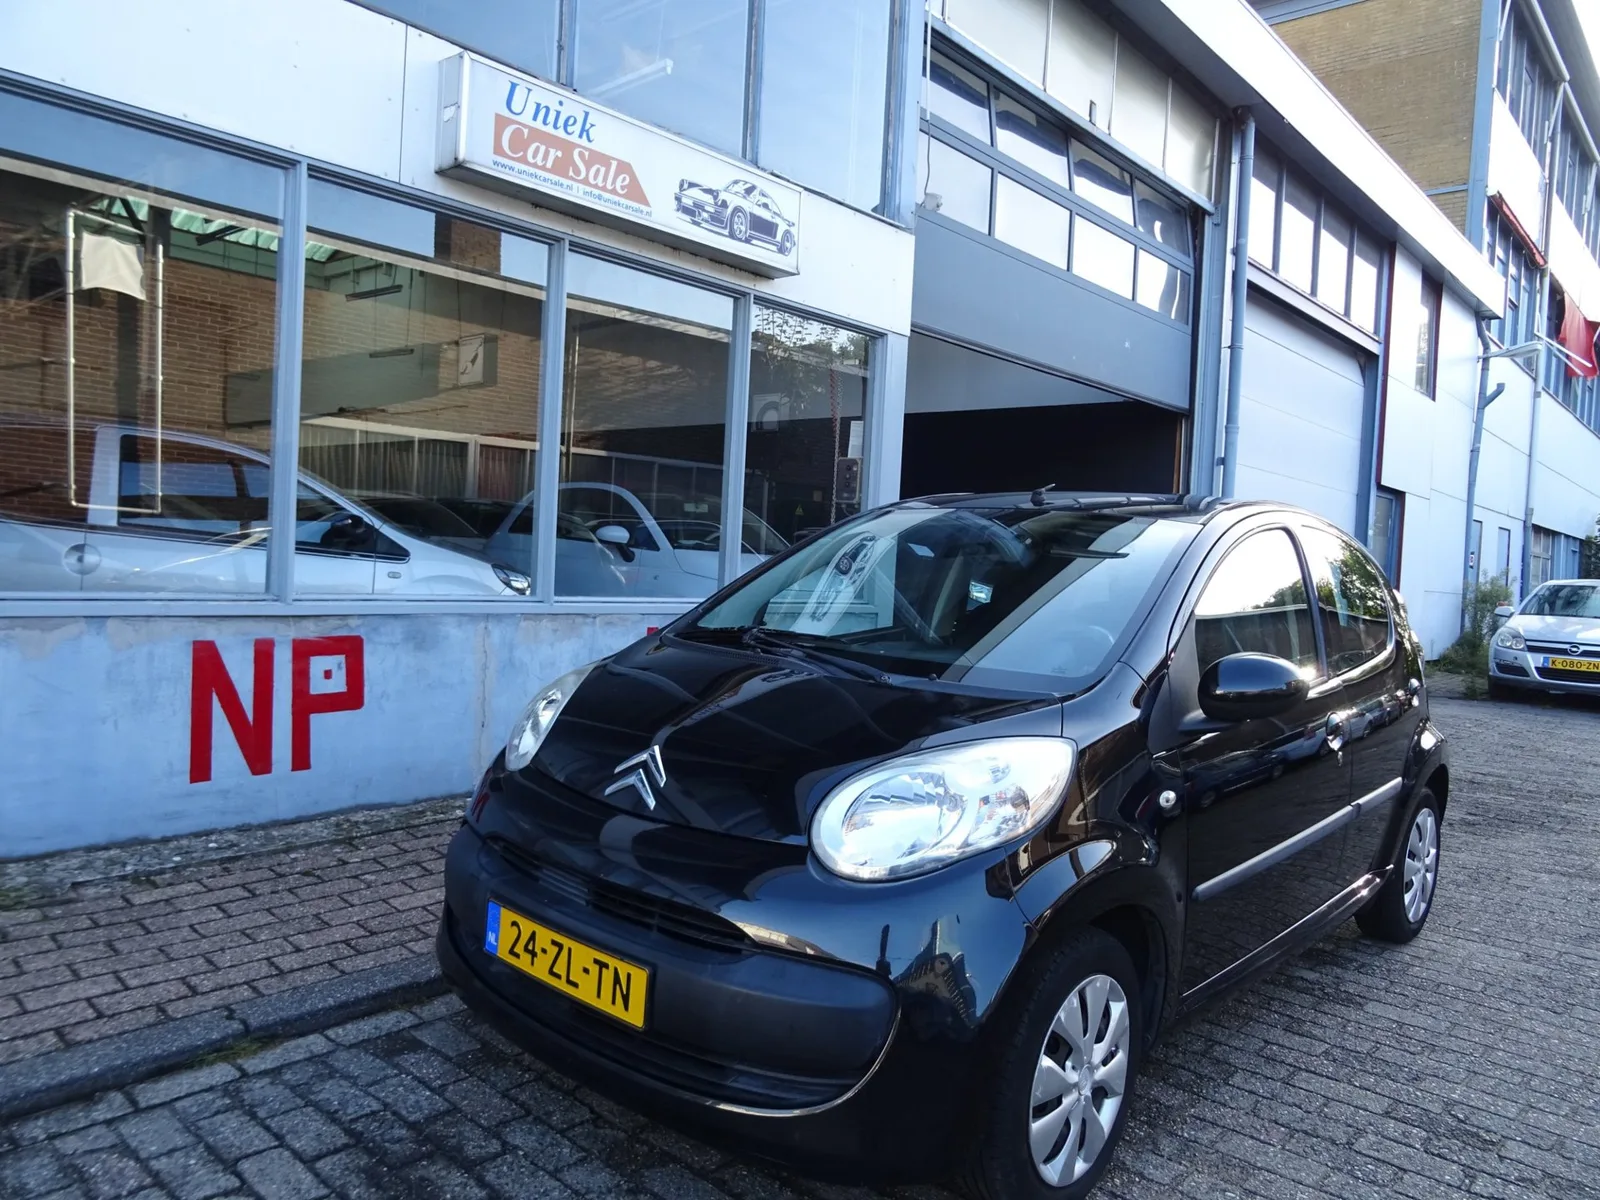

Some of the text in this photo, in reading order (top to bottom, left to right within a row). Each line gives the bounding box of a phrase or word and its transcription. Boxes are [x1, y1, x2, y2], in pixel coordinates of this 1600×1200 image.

[505, 80, 596, 143] Uniek
[492, 159, 652, 218] www.uniekcarsale.nl info@uniekcarsale.nl
[501, 124, 630, 194] Car Sale
[1551, 659, 1599, 670] K-080-ZN
[488, 920, 632, 1012] NL 24-ZL-TN
